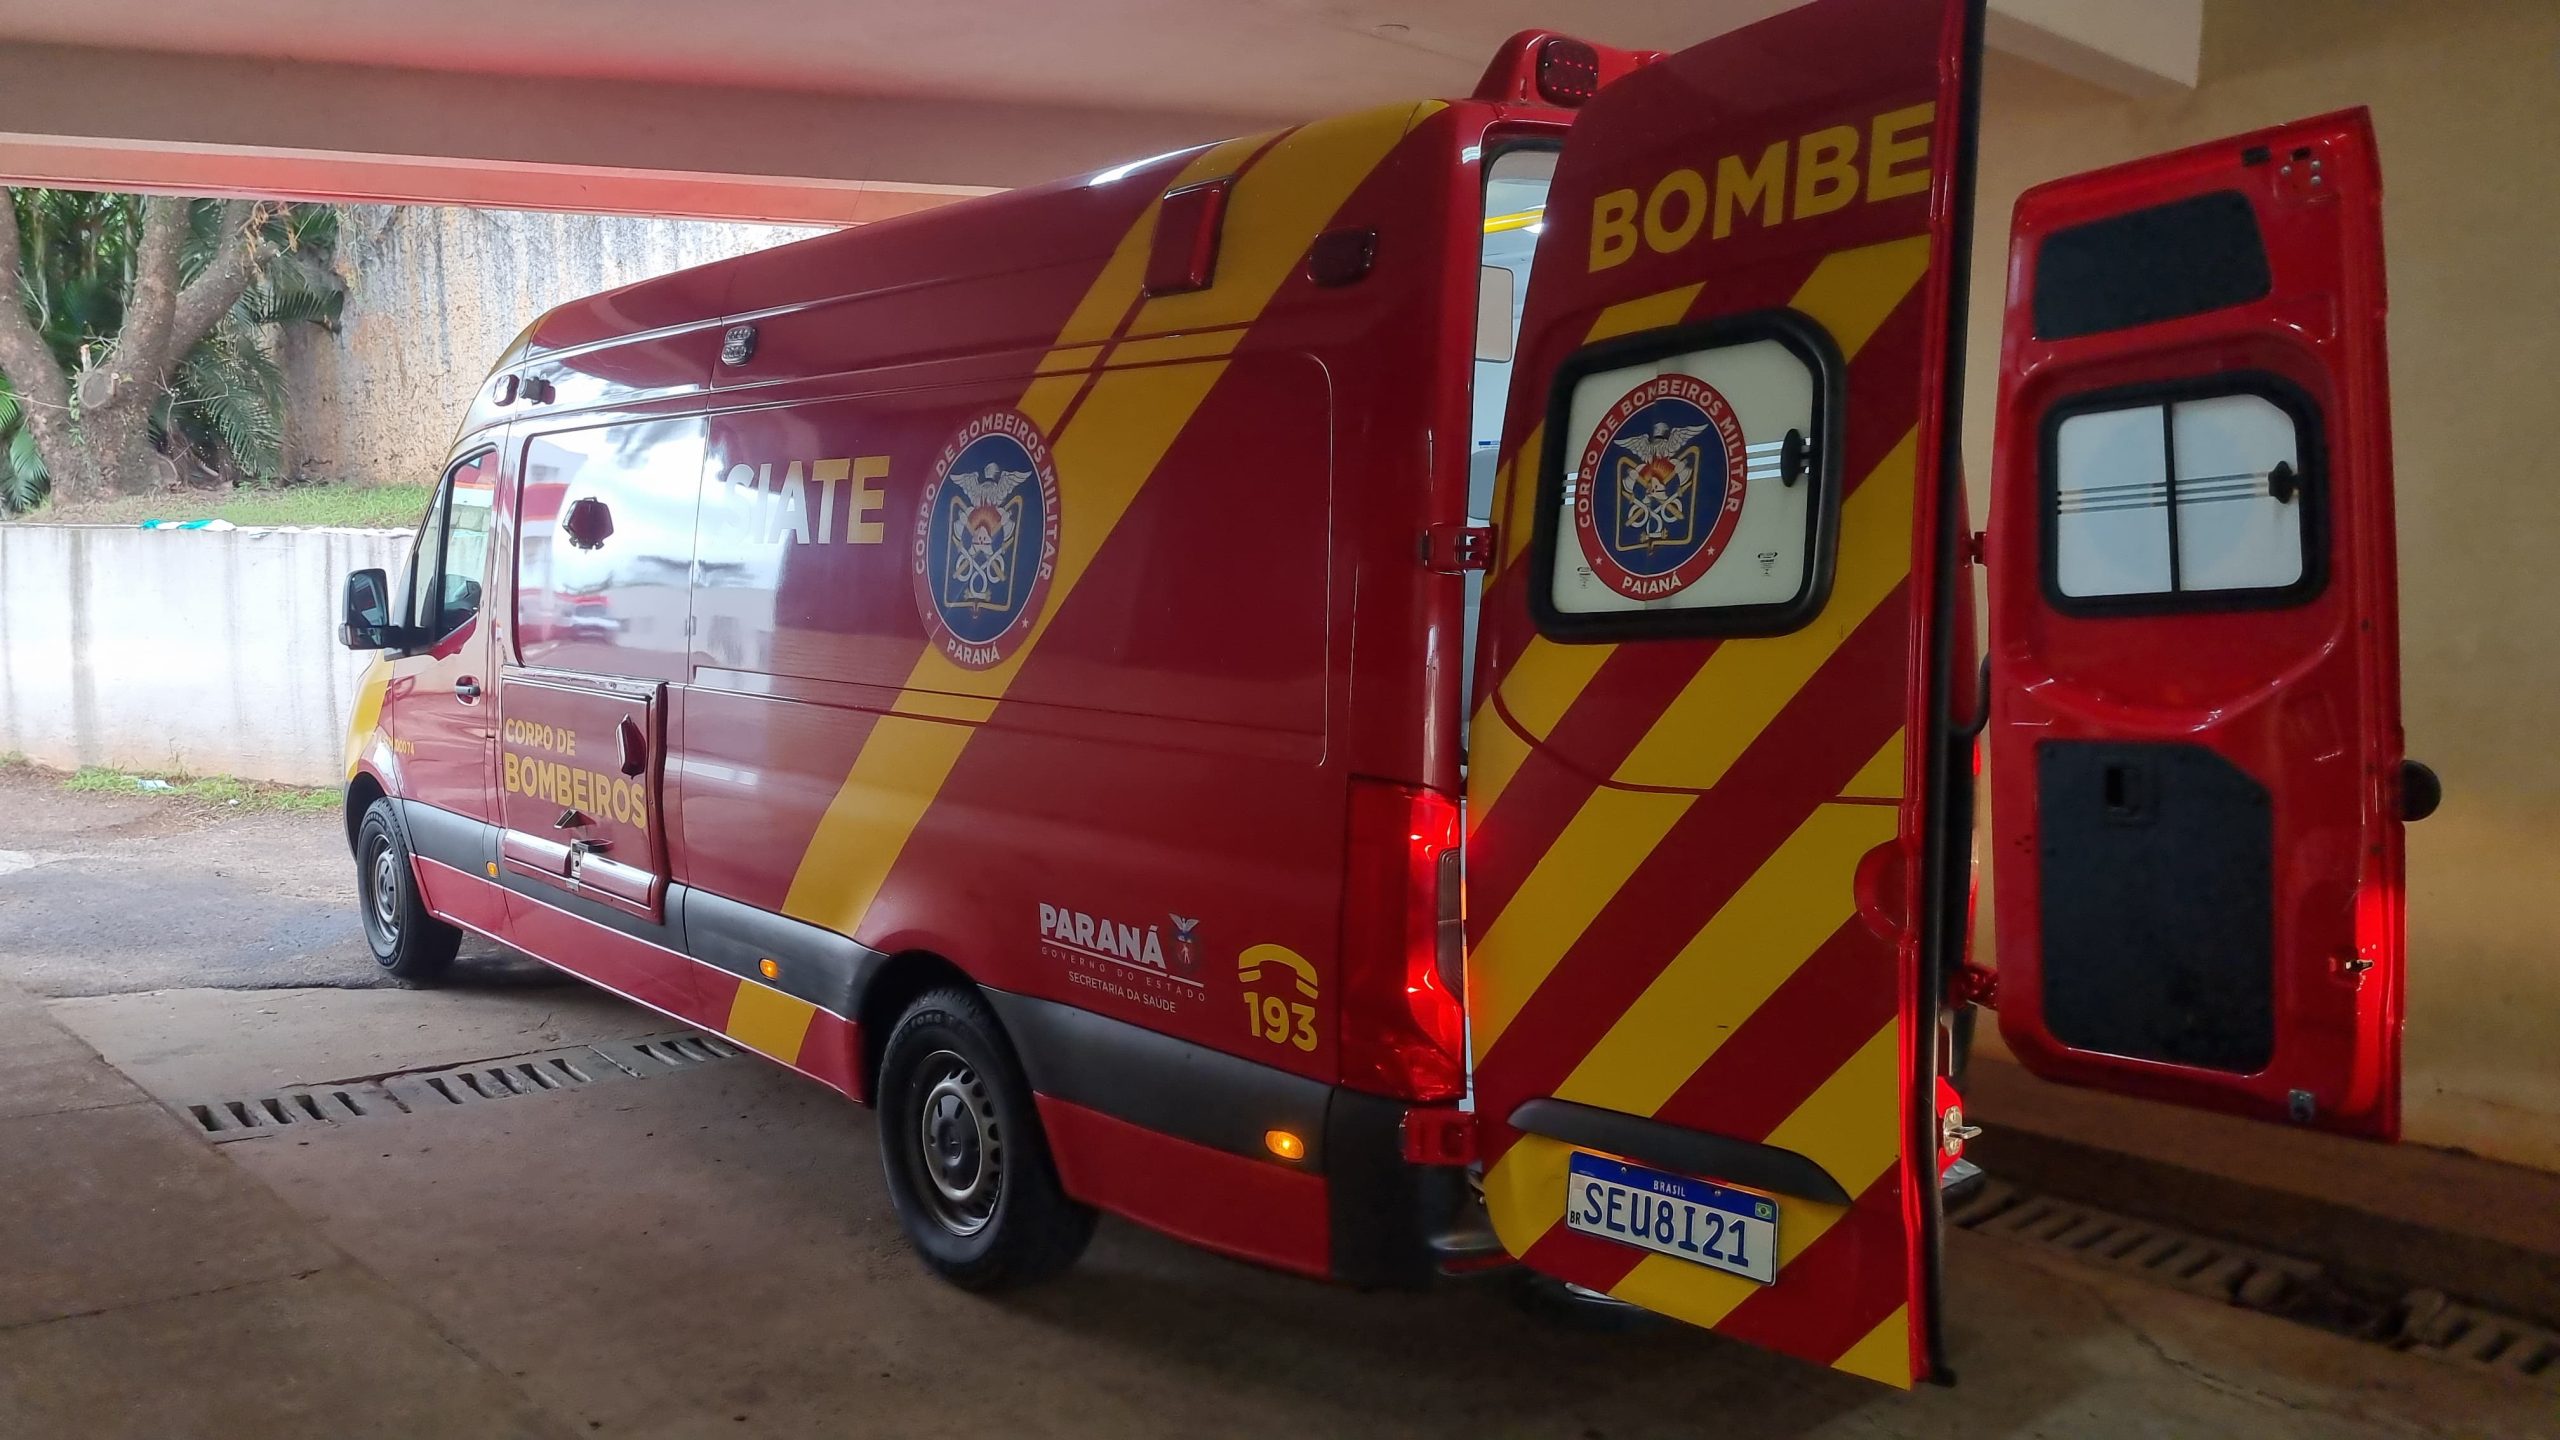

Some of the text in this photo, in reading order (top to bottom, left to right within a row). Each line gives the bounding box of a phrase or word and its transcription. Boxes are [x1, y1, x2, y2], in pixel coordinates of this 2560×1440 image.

[1589, 101, 1936, 273] BOMBE
[721, 455, 890, 545] SIATE
[915, 413, 1059, 580] CORPO DE BOMBEIROS MILITAR
[1577, 450, 1599, 528] CORPO
[1596, 416, 1618, 445] DE
[1719, 416, 1742, 513] MILITAR
[946, 638, 1000, 664] PARANÁ
[505, 718, 576, 756] CORPO DE
[505, 752, 646, 829] BOMBEIROS
[1039, 902, 1166, 970] PARANÁ
[1041, 947, 1205, 1002] GOVERNO DO ESTADO
[1069, 971, 1176, 1013] SECRETARIA DA SAÚDE
[1243, 992, 1318, 1052] 193
[1569, 1210, 1581, 1225] BR
[1653, 1180, 1686, 1197] BRASIL
[1584, 1182, 1749, 1267] SEU8I21
